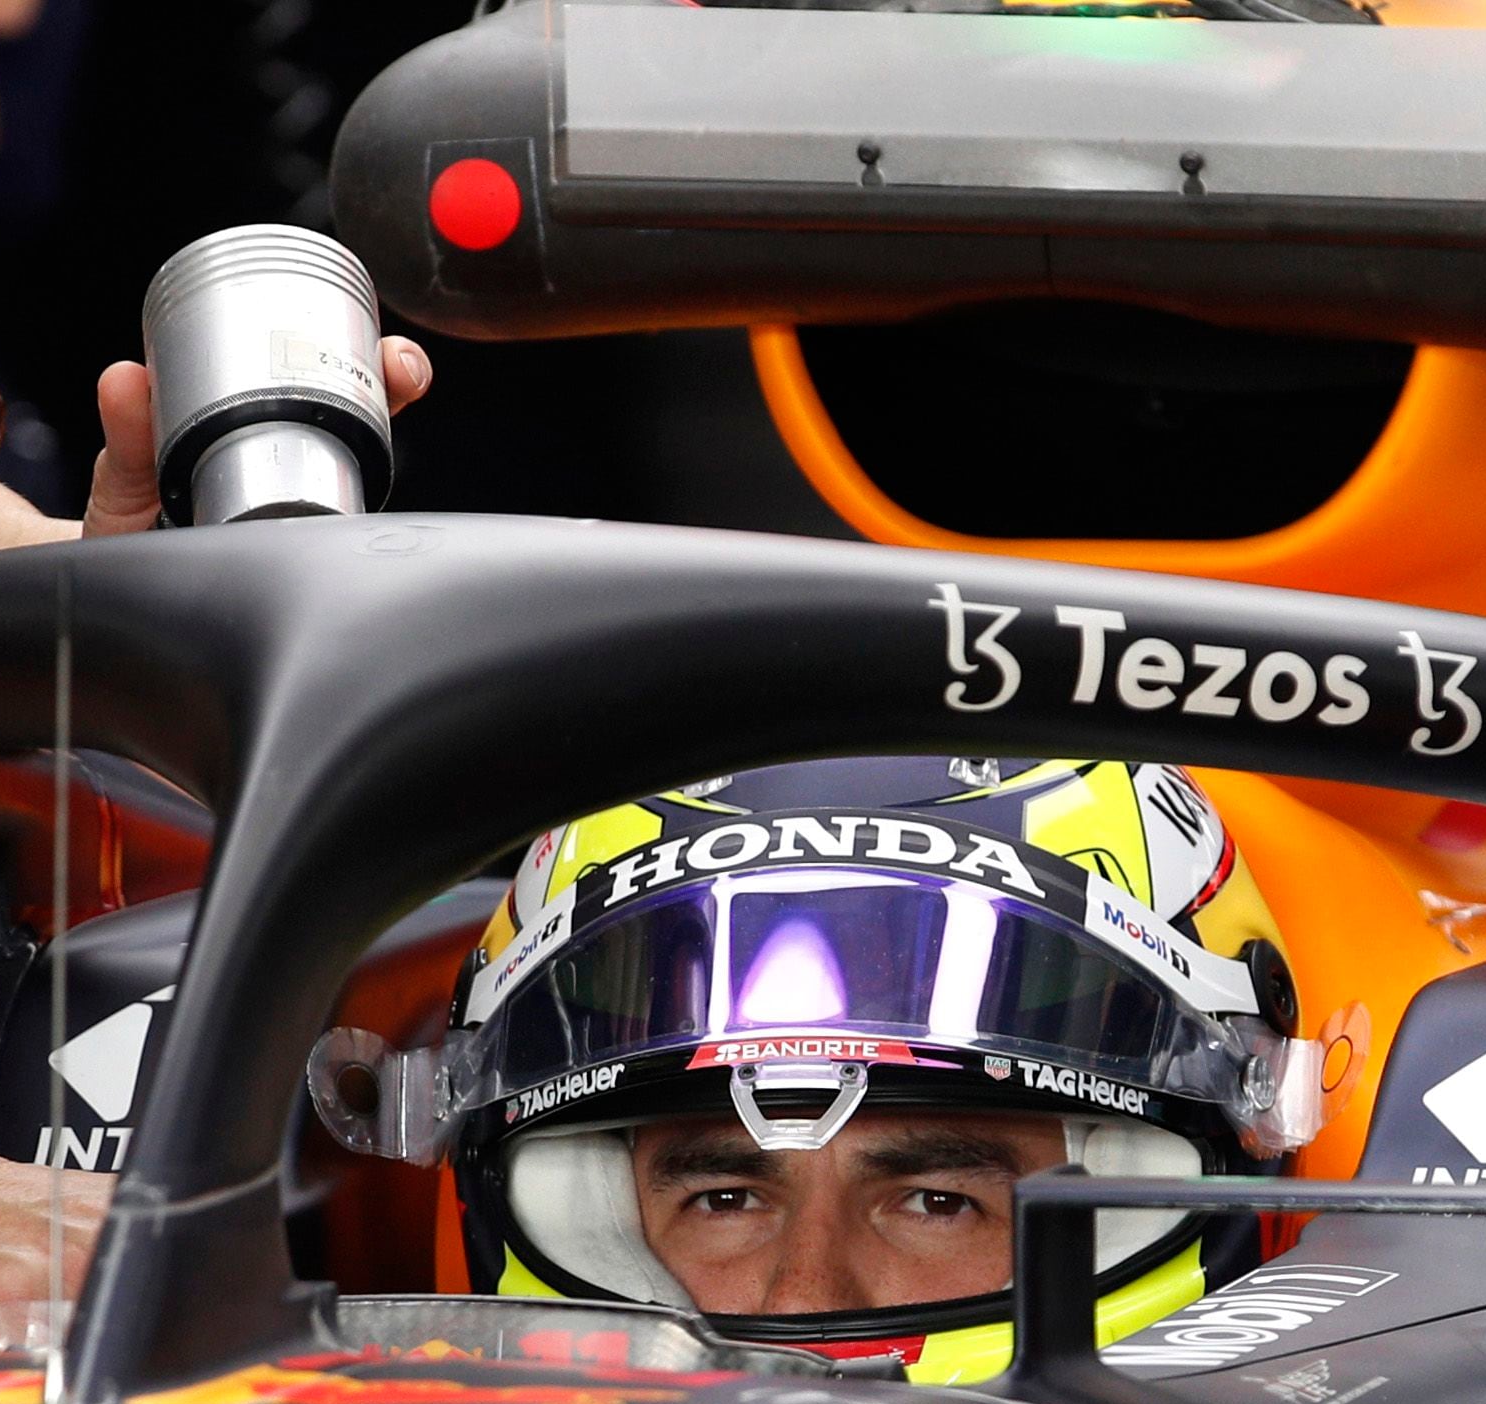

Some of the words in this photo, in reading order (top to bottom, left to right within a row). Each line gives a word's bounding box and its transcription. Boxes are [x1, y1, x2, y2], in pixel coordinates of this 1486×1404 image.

[318, 351, 328, 364] 2
[1054, 605, 1371, 726] Tezos
[603, 815, 1047, 907] HONDA
[1103, 902, 1169, 961] Mobil
[742, 1040, 880, 1059] BANORTE
[1099, 1292, 1346, 1366] Mobil
